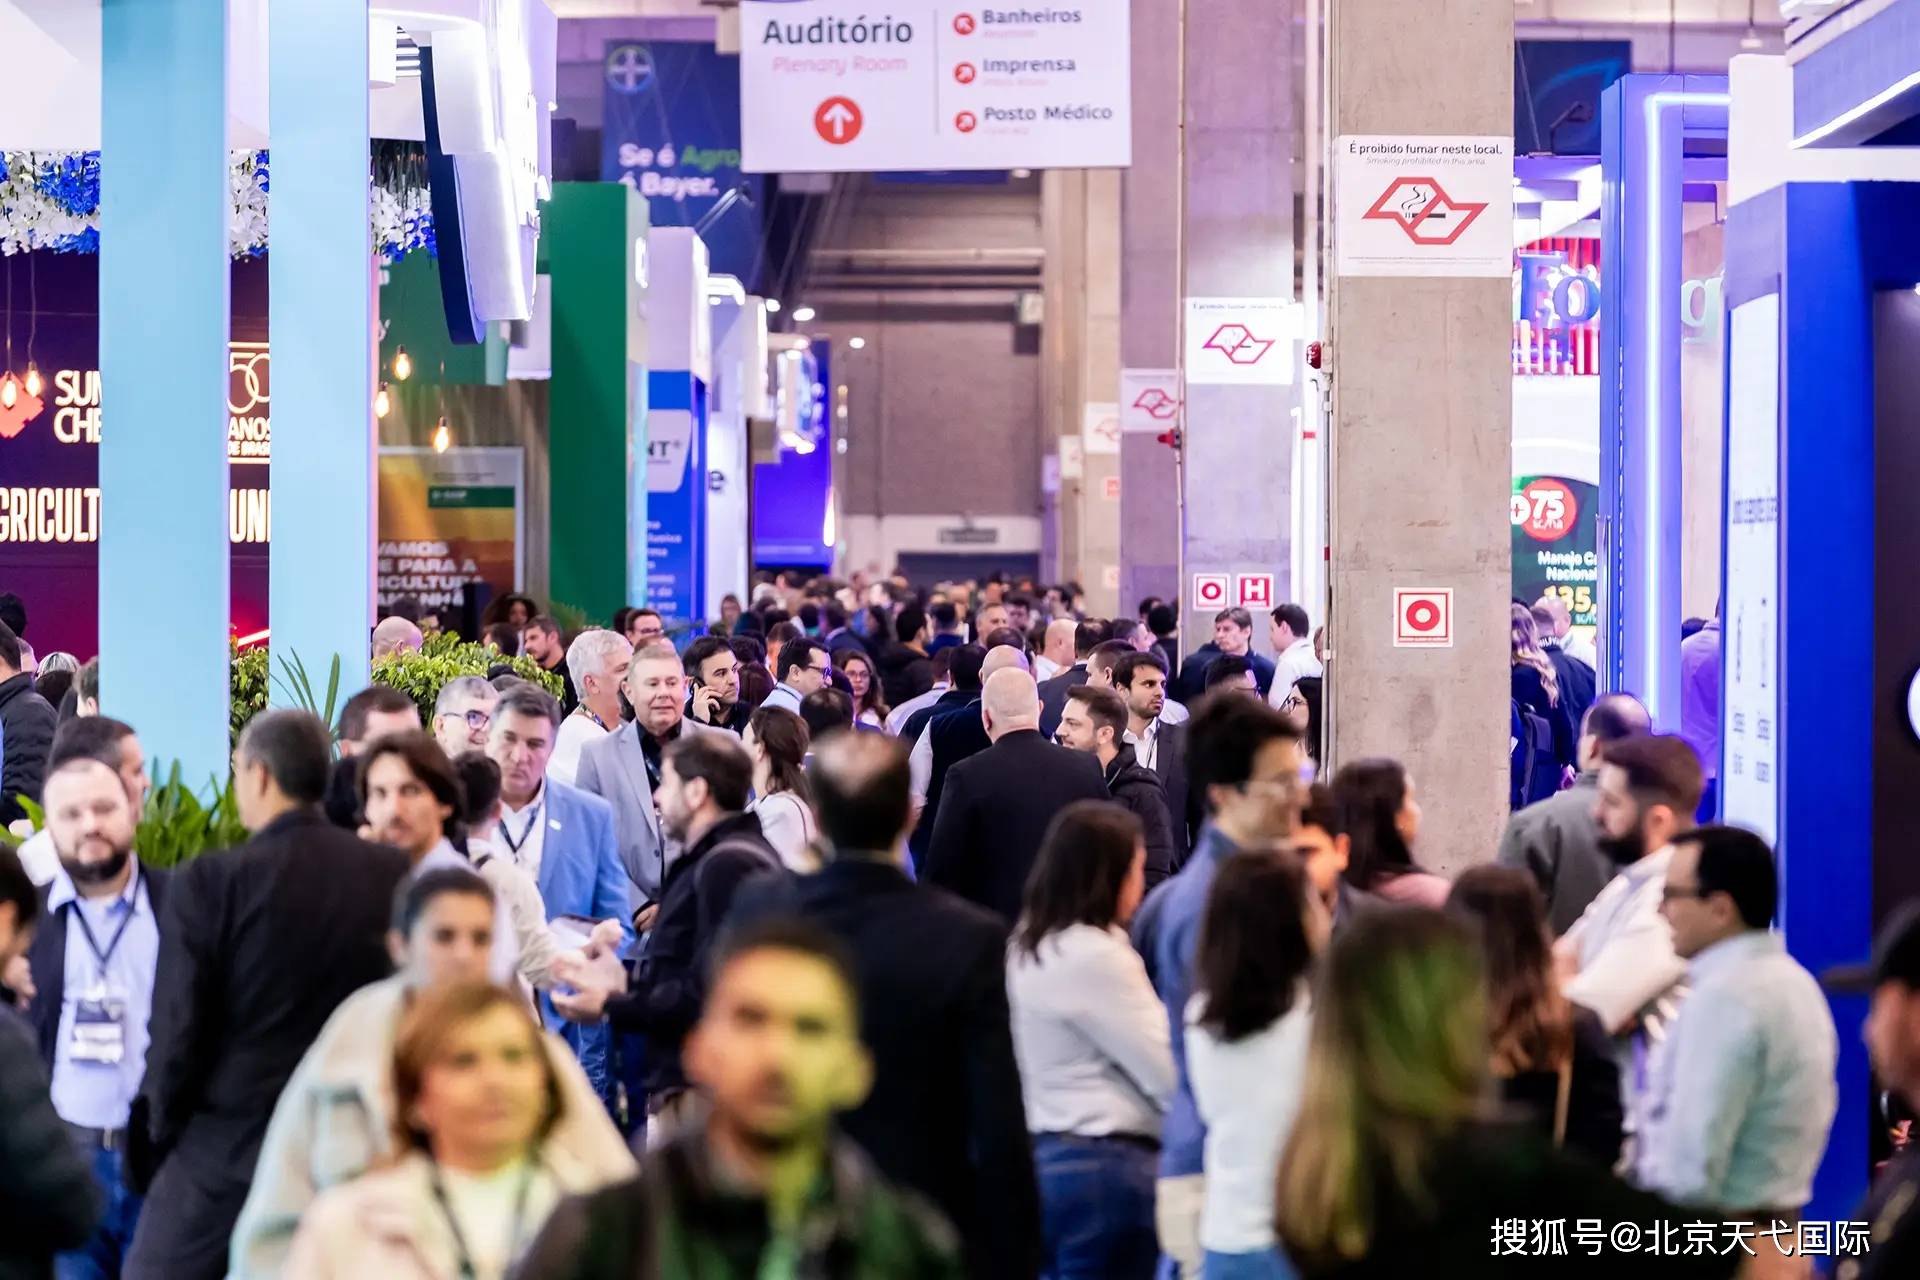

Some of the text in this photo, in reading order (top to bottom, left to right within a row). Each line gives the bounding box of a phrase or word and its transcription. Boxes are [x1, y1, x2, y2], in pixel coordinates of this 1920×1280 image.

[982, 8, 1082, 24] Banheiros
[763, 15, 913, 44] Auditório
[772, 55, 908, 76] Plenary Room
[983, 58, 1076, 74] Imprensa
[984, 103, 1113, 121] Posto Médico
[619, 143, 653, 167] Se
[1350, 139, 1502, 155] É proibido fumar neste local.
[1366, 157, 1400, 166] Smoking
[1402, 157, 1441, 166] prohibited
[1530, 490, 1564, 520] 75
[398, 558, 457, 573] PARA
[463, 558, 476, 573] A
[1245, 579, 1265, 600] H
